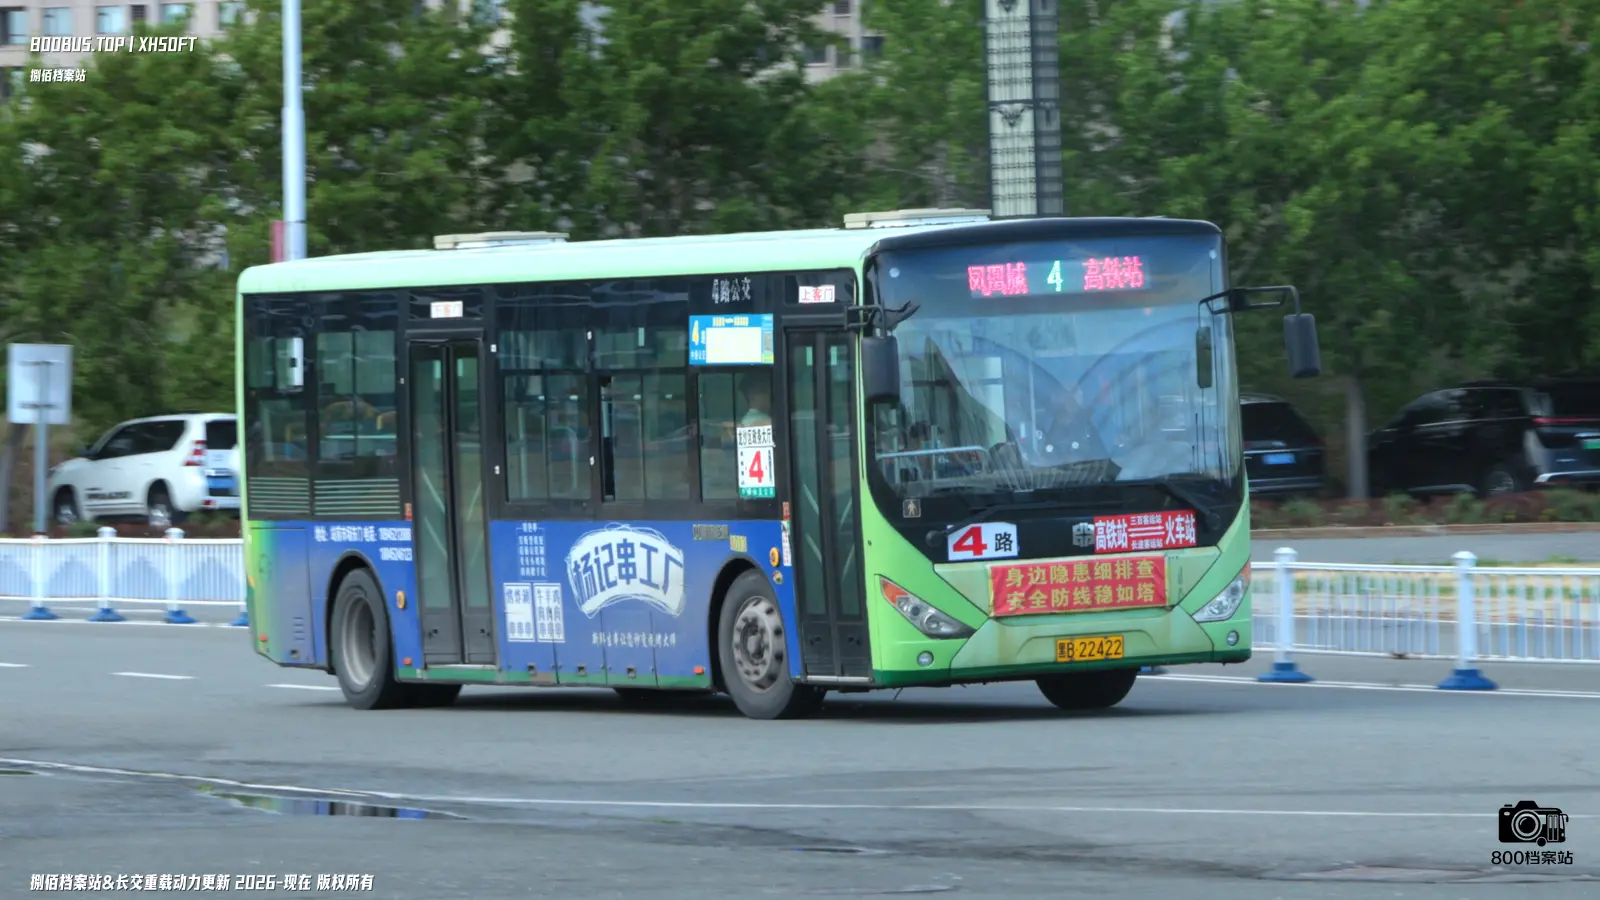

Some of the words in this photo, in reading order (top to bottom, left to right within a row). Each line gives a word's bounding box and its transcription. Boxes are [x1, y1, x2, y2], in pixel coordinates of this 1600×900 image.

[967, 262, 1029, 296] 凤凰城
[1047, 260, 1063, 292] 4
[1082, 256, 1143, 290] 高铁站
[801, 288, 834, 302] 上客门
[749, 450, 764, 483] 4
[953, 526, 988, 556] 4
[995, 532, 1013, 552] 路
[1095, 519, 1128, 550] 高铁站
[1165, 513, 1196, 545] 火车站
[1006, 559, 1155, 588] 身边隐患细排查
[1006, 582, 1155, 611] 安全防线稳如塔
